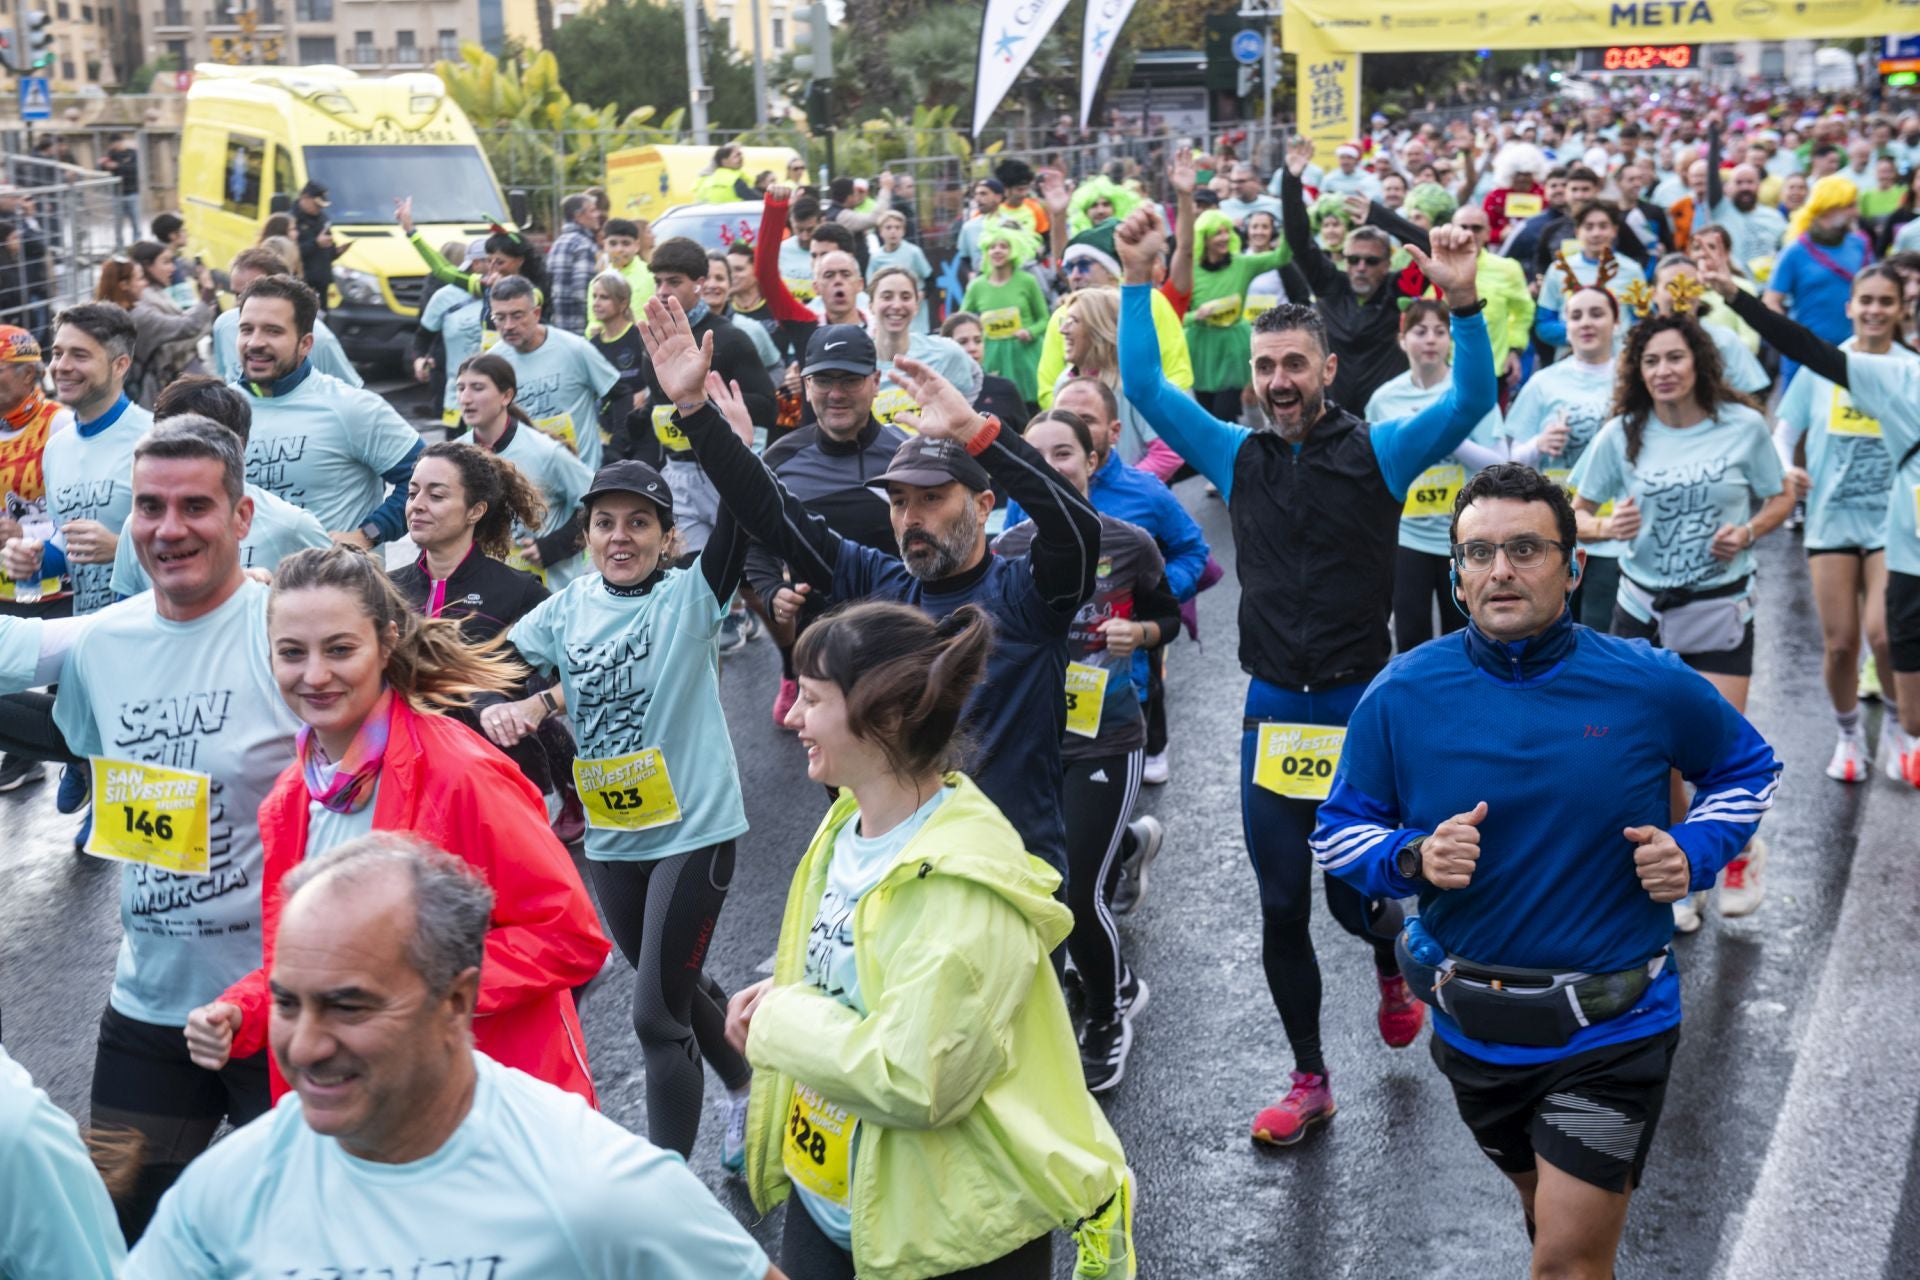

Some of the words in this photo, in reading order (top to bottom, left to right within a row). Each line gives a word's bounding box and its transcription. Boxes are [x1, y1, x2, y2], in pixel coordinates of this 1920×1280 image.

[1610, 2, 1713, 27] META
[1308, 60, 1346, 79] SAN
[1642, 457, 1728, 497] SAN
[57, 480, 114, 515] SAN
[1416, 488, 1448, 503] 637
[1655, 485, 1716, 522] SIL
[1650, 507, 1723, 549] VES
[566, 624, 650, 675] SAN
[578, 665, 646, 708] SIL
[115, 690, 232, 747] SAN
[1268, 734, 1342, 757] SILVESTR
[1270, 729, 1302, 744] SAN
[107, 767, 145, 785] SAN
[579, 764, 602, 779] SAN
[582, 754, 655, 793] SILVESTRE
[624, 768, 656, 788] MURCIA
[1282, 756, 1332, 778] 020
[105, 780, 198, 804] SILVESTRE
[599, 788, 643, 810] 123
[124, 806, 173, 841] 146
[131, 867, 249, 915] MURCIA
[808, 1112, 842, 1136] MURCIA
